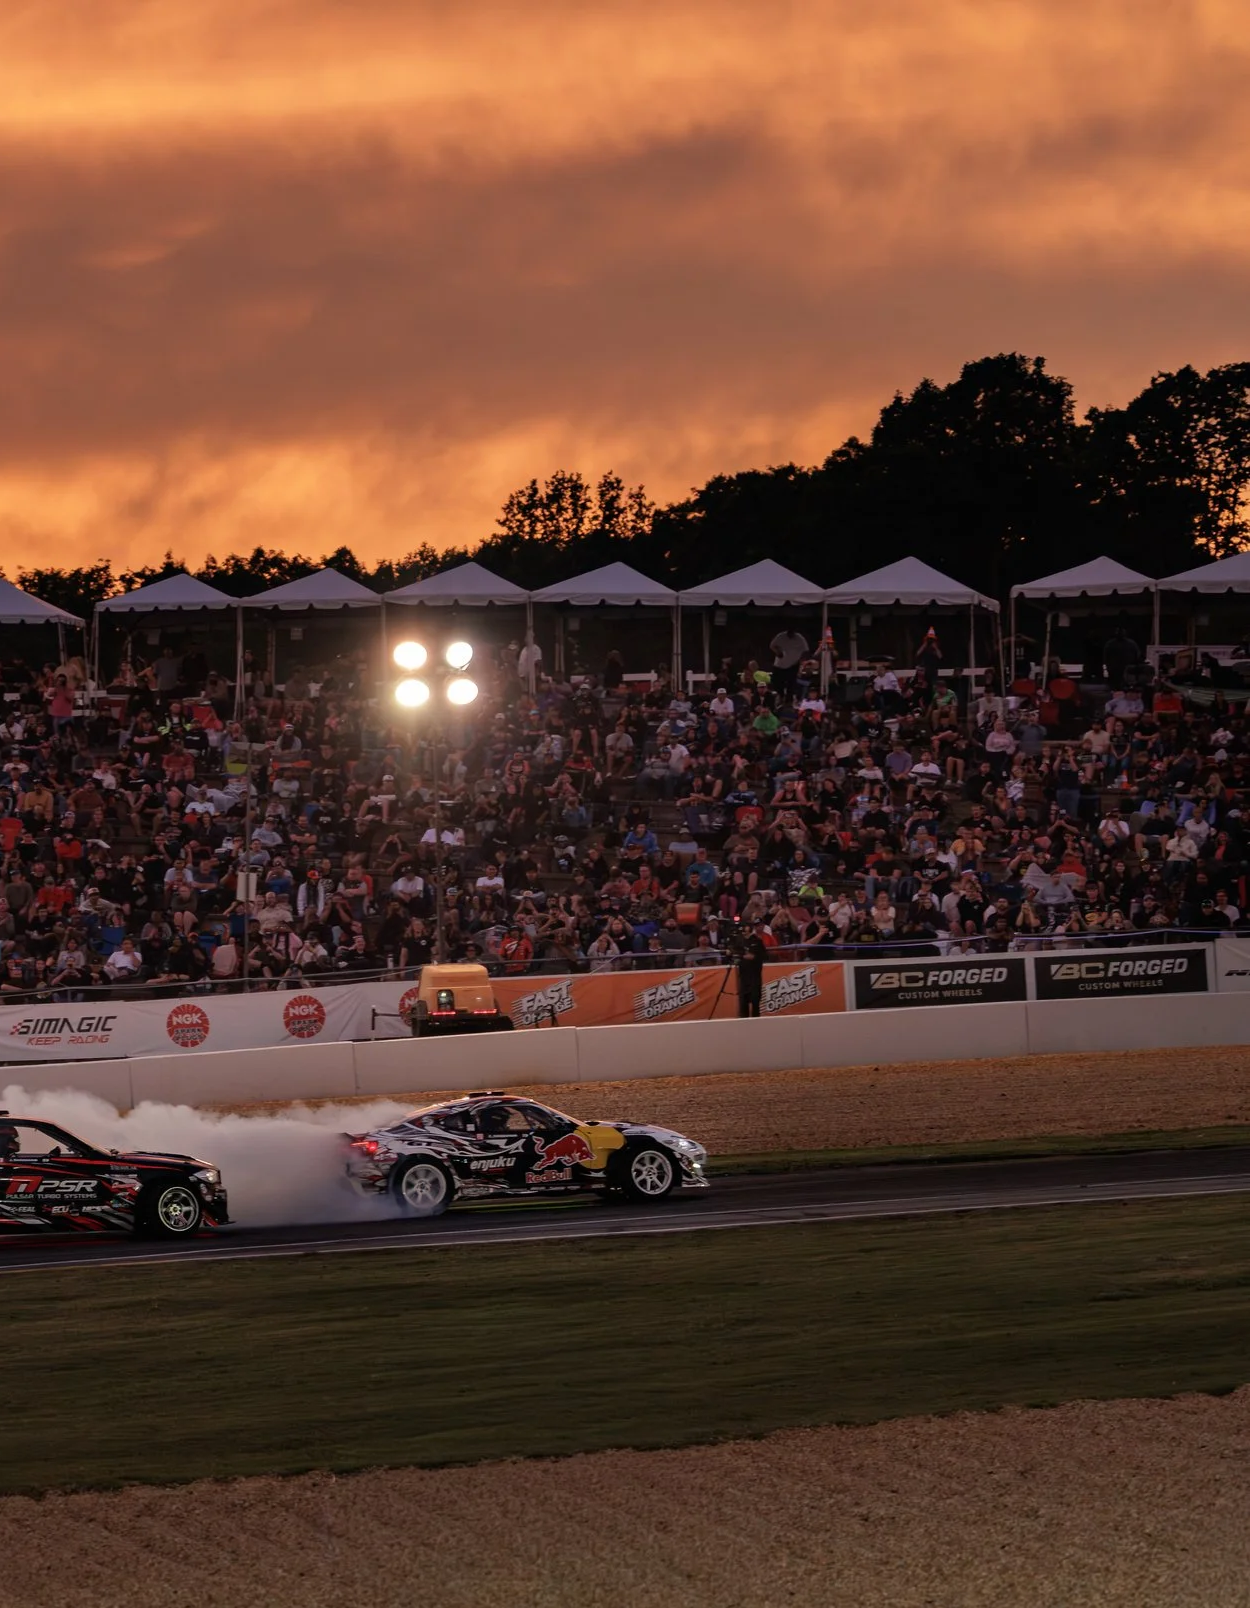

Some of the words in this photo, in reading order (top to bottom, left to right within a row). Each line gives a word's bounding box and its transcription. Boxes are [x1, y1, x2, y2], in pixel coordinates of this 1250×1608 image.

[926, 967, 1008, 986] FORGED
[1107, 958, 1189, 977] FORGED
[644, 973, 694, 1008] FAST
[765, 966, 816, 1001] FAST
[1078, 980, 1120, 991] CUSTOM
[1123, 979, 1164, 988] WHEELS
[521, 979, 573, 1013] FAST
[766, 984, 818, 1012] ORANGE
[898, 991, 939, 1000] CUSTOM
[942, 988, 983, 998] WHEELS
[289, 1004, 318, 1017] NGK
[522, 997, 574, 1025] OGE
[644, 990, 695, 1019] ORANGE
[18, 1015, 117, 1035] SIMAGIC
[172, 1013, 202, 1025] NGK
[26, 1036, 62, 1046] KEEP
[67, 1034, 110, 1045] RACING
[470, 1156, 516, 1172] enjuku
